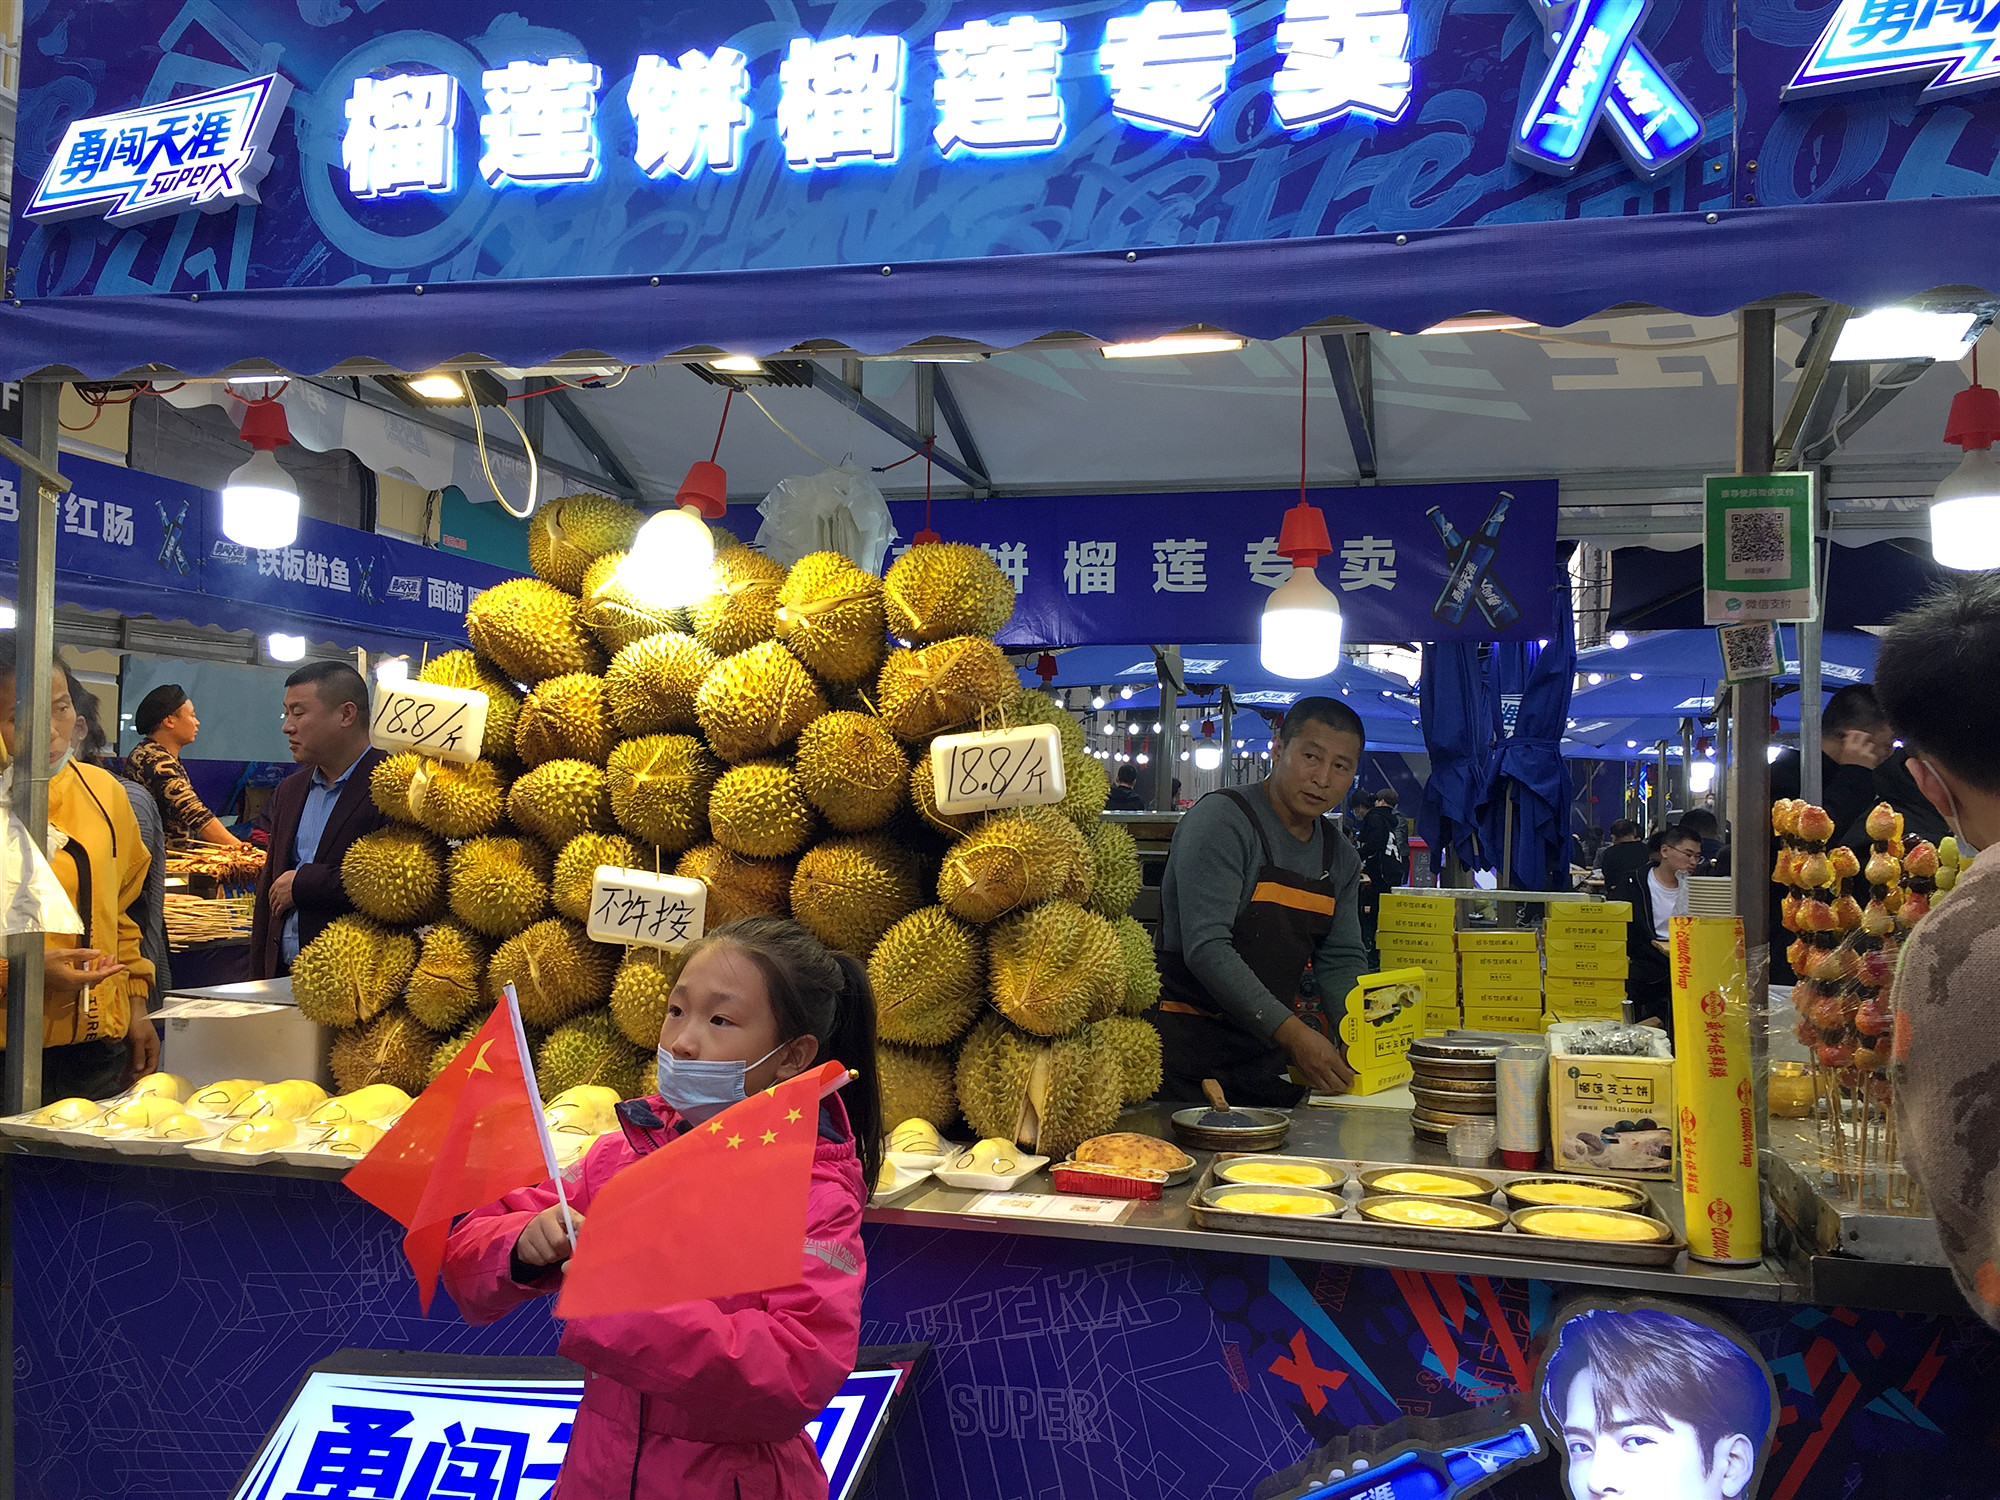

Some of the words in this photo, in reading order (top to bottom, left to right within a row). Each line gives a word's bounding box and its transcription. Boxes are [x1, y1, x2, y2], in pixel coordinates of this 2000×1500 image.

[60, 109, 236, 186] 勇闯天涯
[0, 479, 135, 546] 色红肠
[256, 548, 351, 592] 铁板鱿鱼
[1745, 600, 1791, 610] 微信支付
[374, 693, 467, 751] 18.8/斤
[947, 738, 1047, 803] 18.8/斤
[595, 888, 695, 943] 不许按
[1578, 1081, 1649, 1097] 榴莲芝士饼
[948, 1384, 1102, 1443] SUPER
